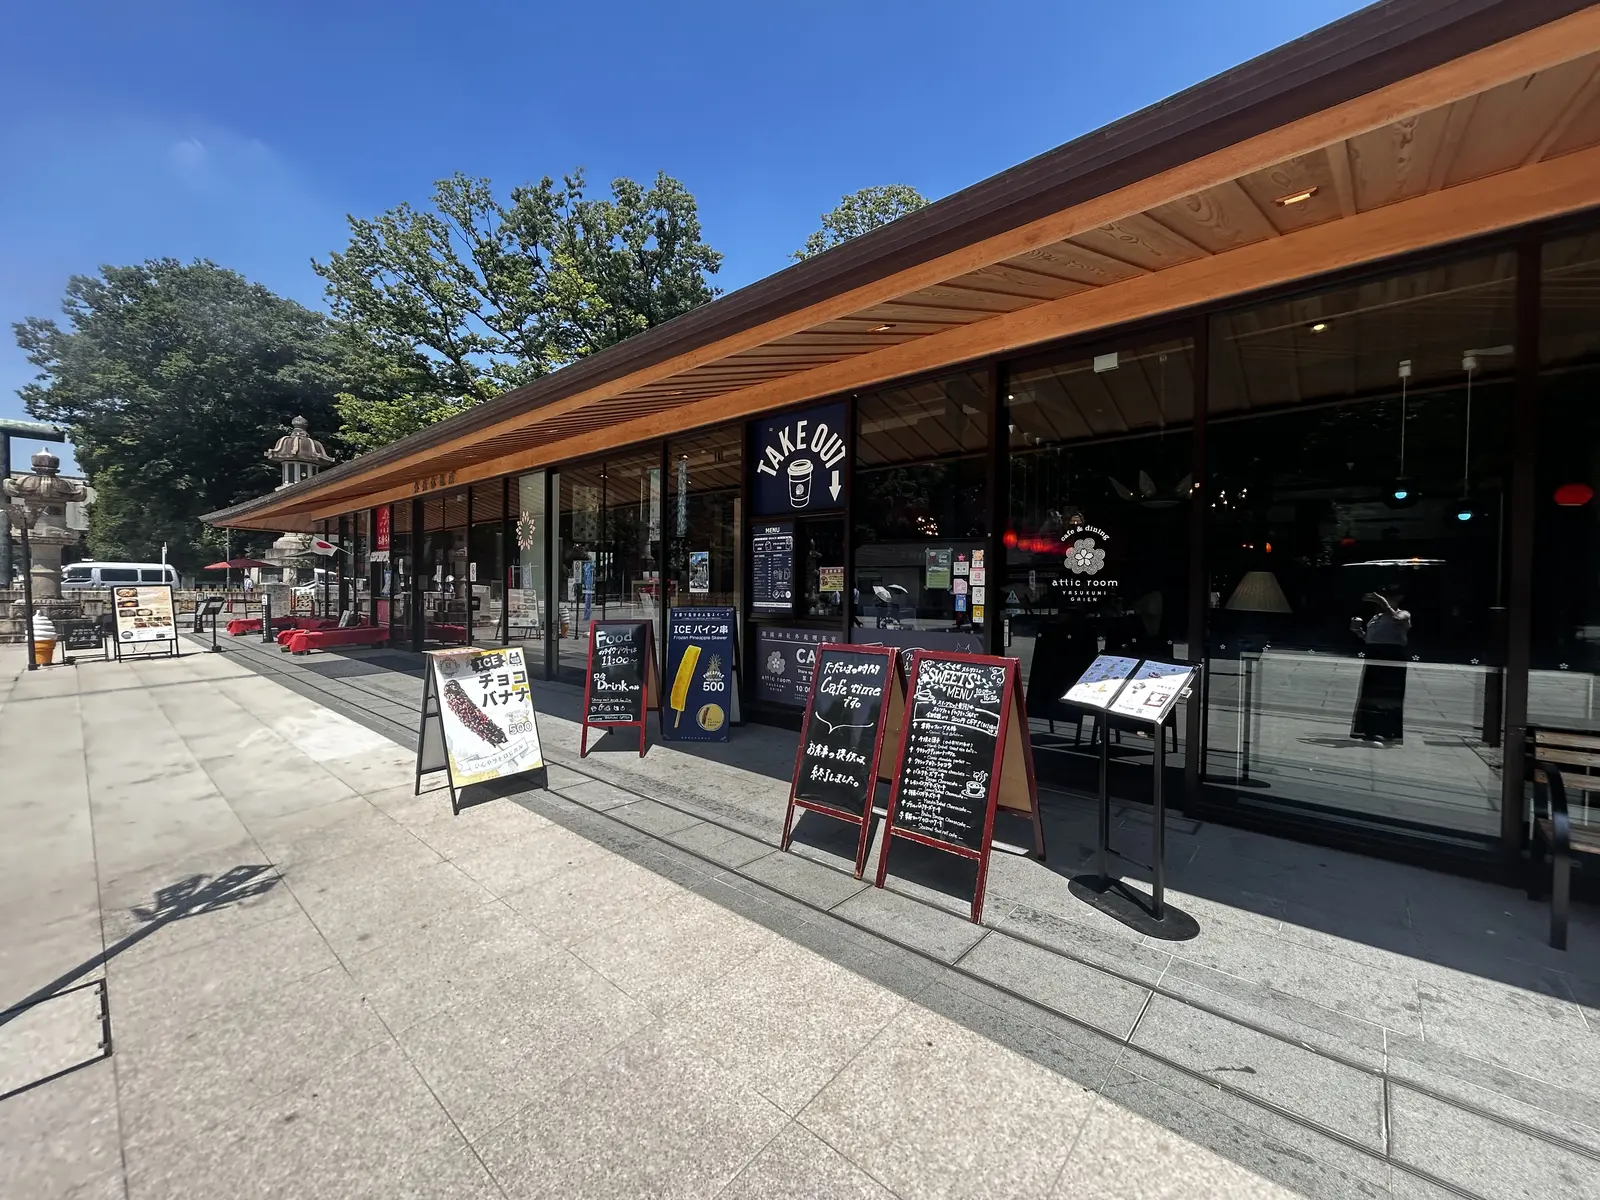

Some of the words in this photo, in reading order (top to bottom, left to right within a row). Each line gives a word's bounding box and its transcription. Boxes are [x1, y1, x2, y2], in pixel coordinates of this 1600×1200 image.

[757, 420, 808, 476] TAKE
[811, 423, 846, 469] OUT
[1061, 530, 1075, 541] cafe
[1085, 525, 1110, 541] dining
[1052, 579, 1081, 587] attic
[674, 625, 691, 634] ICE
[693, 624, 729, 634] パイン串
[596, 628, 632, 648] Food
[477, 656, 500, 669] ICE
[479, 670, 528, 689] チョコ
[597, 680, 629, 691] Drink
[928, 667, 979, 689] SWEETS
[703, 681, 725, 692] 500
[820, 676, 847, 696] Cafe
[850, 684, 881, 696] time
[946, 686, 974, 701] MENU
[482, 687, 530, 708] バナナ
[508, 720, 533, 735] 500
